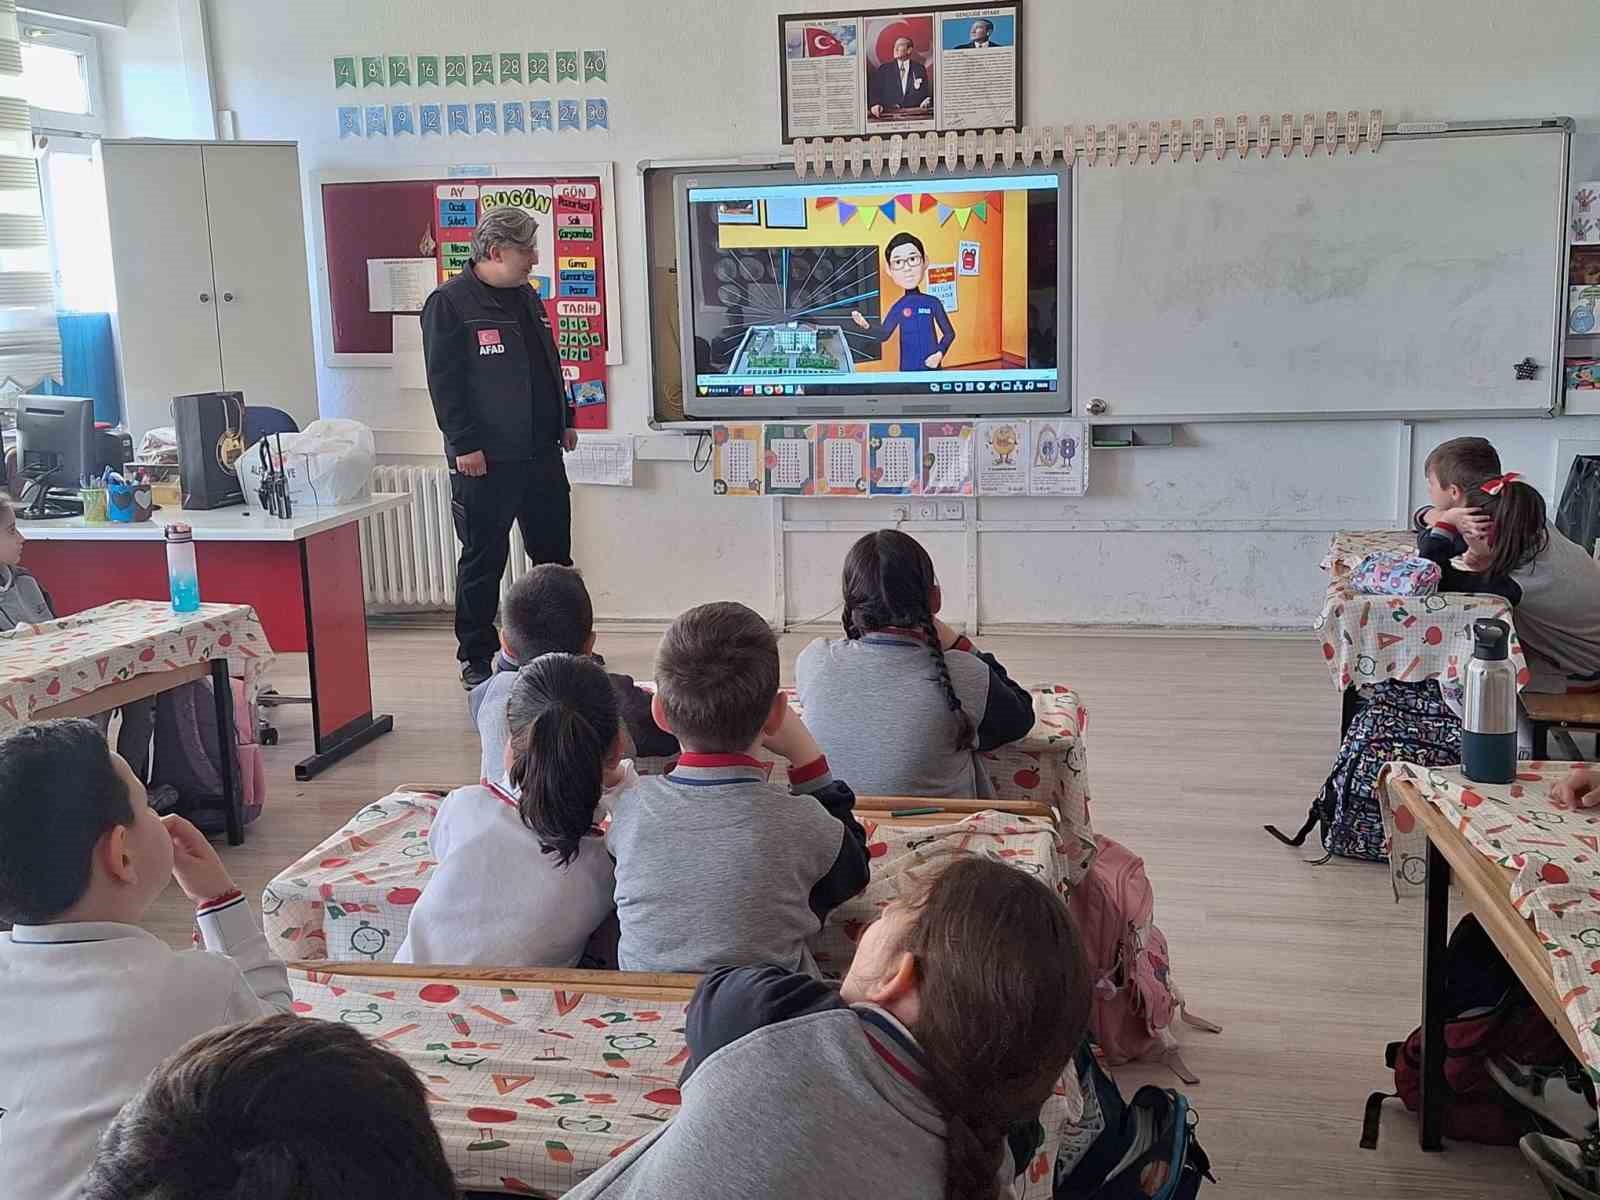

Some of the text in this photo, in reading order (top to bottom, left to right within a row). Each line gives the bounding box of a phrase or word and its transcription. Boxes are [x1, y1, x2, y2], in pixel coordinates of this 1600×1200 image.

[340, 57, 605, 78] 4 8 12 16 20 24 28 32 36 40
[423, 111, 439, 129] 12
[559, 106, 577, 121] 27
[450, 187, 464, 198] AY
[562, 186, 586, 198] GÜN
[481, 187, 552, 214] BUGÜN
[562, 302, 597, 315] TARİH
[480, 344, 505, 355] AFAD
